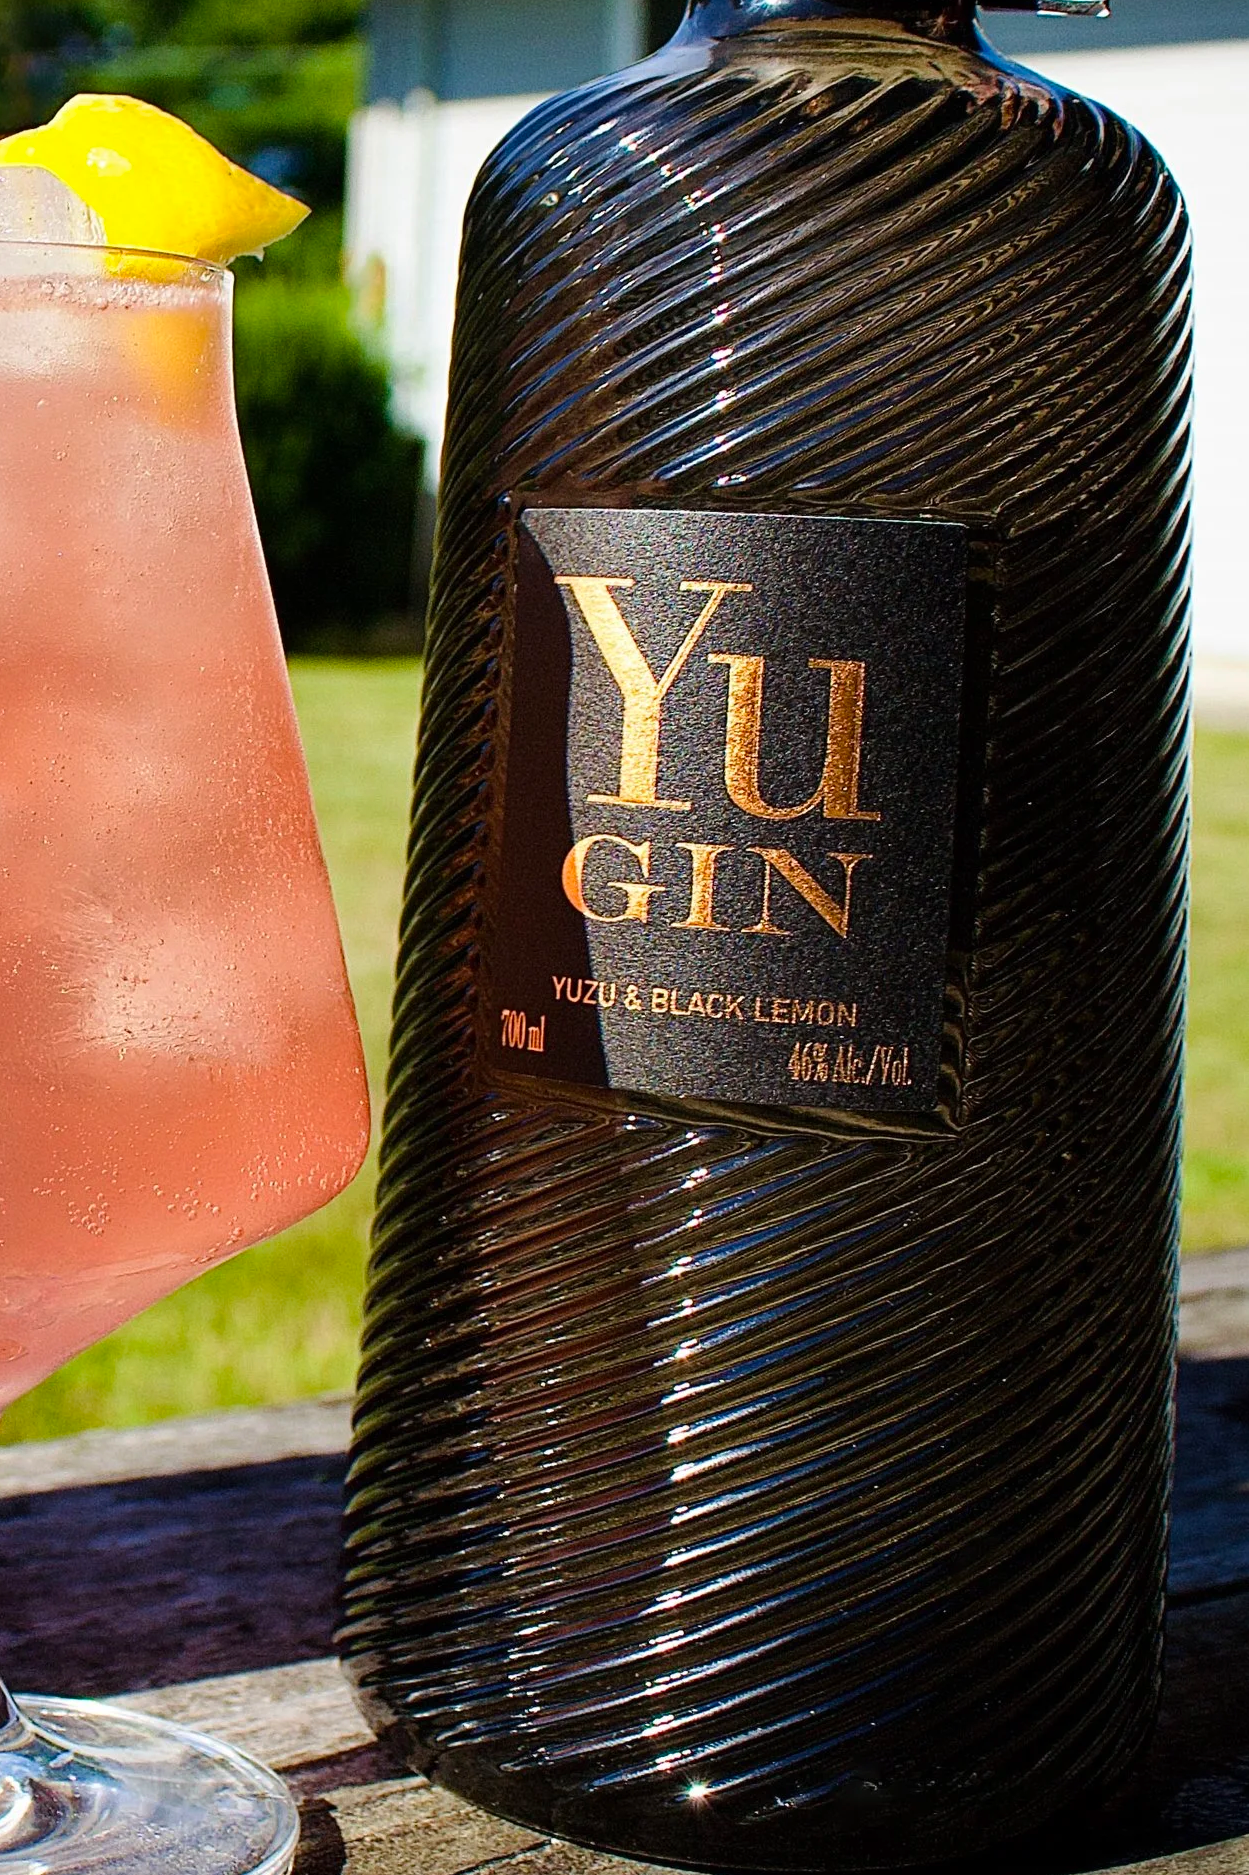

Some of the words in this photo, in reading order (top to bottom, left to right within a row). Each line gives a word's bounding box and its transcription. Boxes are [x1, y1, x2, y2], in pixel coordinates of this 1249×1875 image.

[554, 576, 880, 822] Yu
[562, 834, 873, 938] GIN
[552, 976, 616, 1008] YUZU
[624, 988, 643, 1012] &
[651, 988, 745, 1021] BLACK
[753, 997, 857, 1028] LEMON
[787, 1041, 828, 1083] 46%
